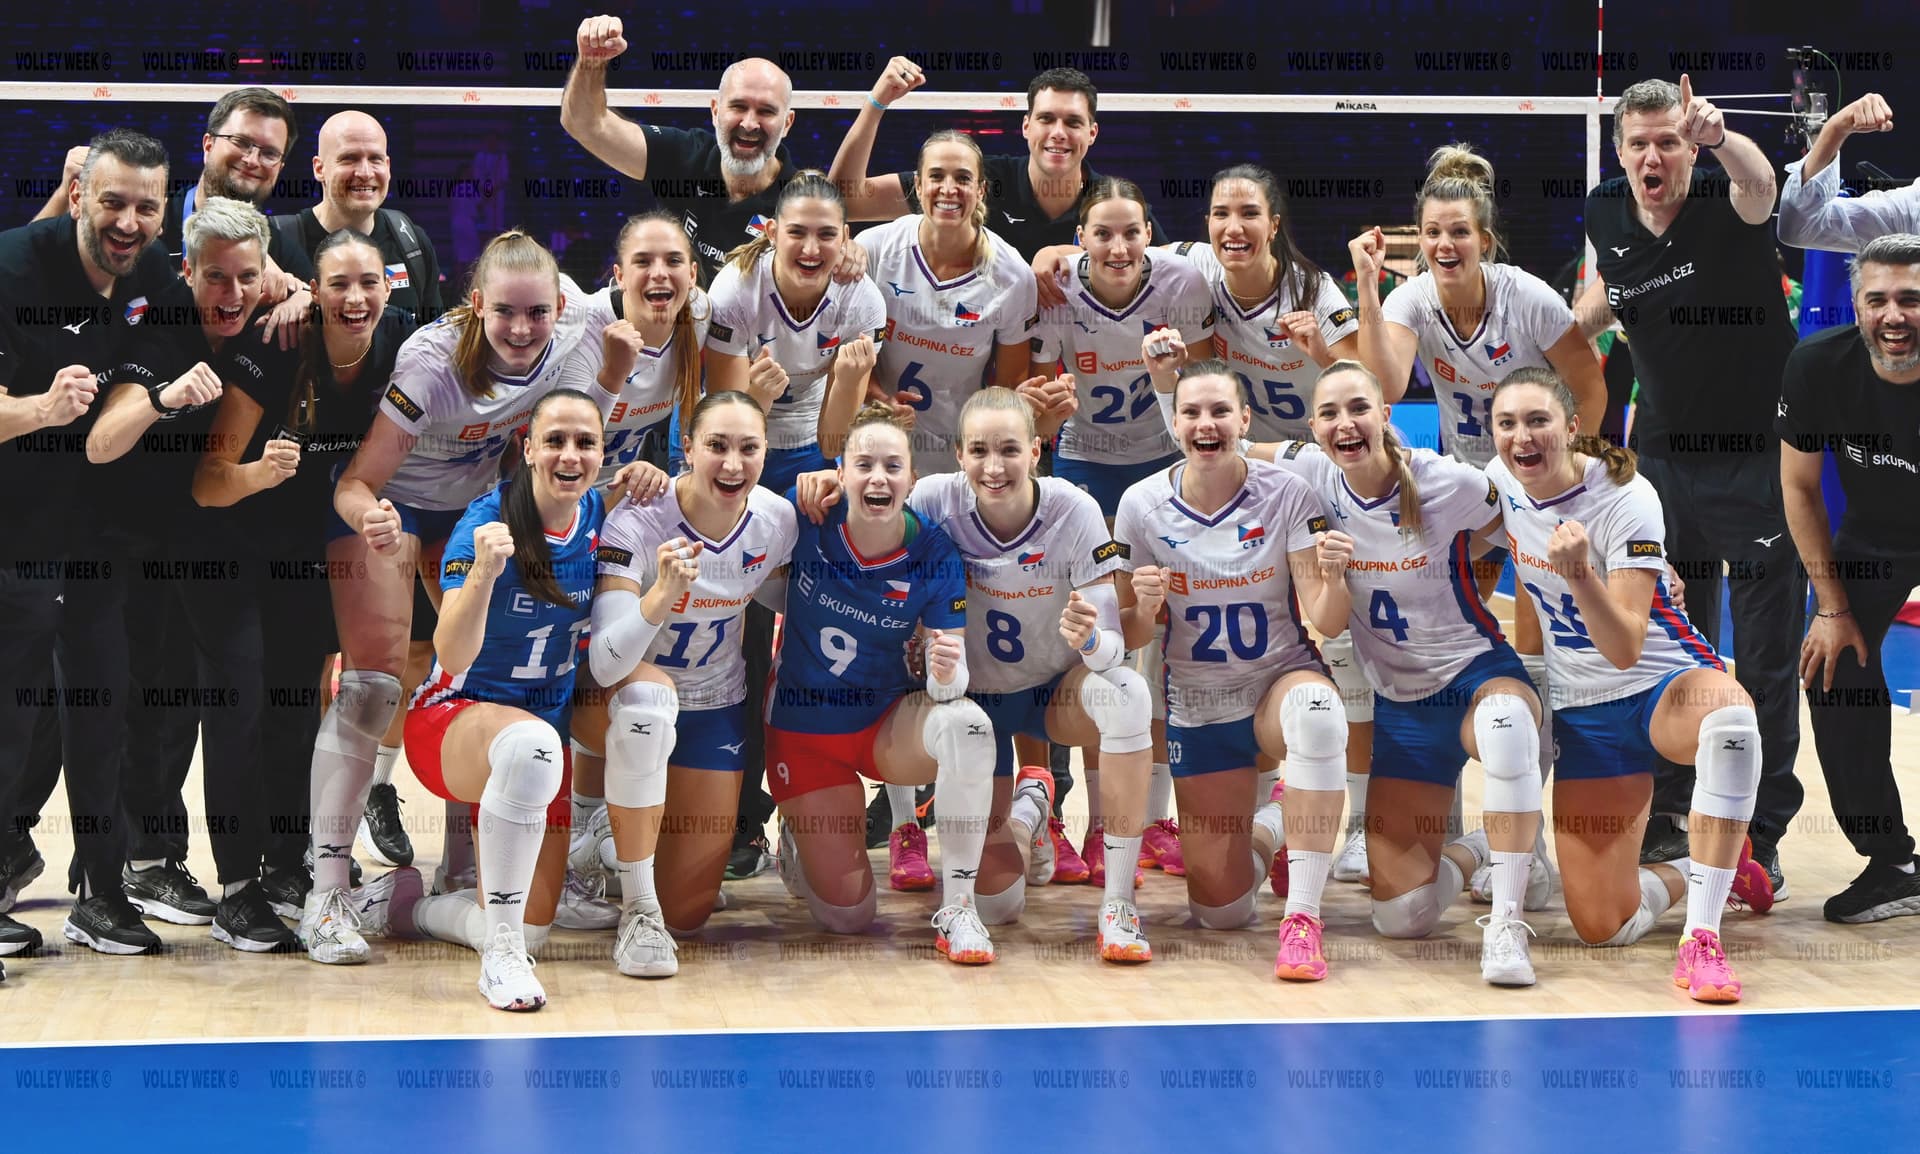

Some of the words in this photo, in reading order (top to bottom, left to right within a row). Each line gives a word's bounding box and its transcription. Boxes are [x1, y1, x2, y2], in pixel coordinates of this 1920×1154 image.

[1622, 273, 1673, 300] SKUPINA
[1671, 261, 1695, 280] ČEZ
[896, 331, 948, 354] SKUPINA
[950, 344, 975, 357] ČEZ
[1231, 351, 1279, 372] SKUPINA
[1281, 359, 1305, 372] ČEZ
[898, 361, 933, 412] 6
[307, 440, 361, 452] SKUPIN
[1243, 538, 1265, 550] CZE
[1401, 555, 1428, 571] ČEZ
[1193, 576, 1249, 590] SKUPINA
[1251, 566, 1276, 584] ČEZ
[692, 597, 742, 609] SKUPINA
[975, 582, 1025, 600] SKUPINA
[1027, 585, 1055, 598] ČEZ
[818, 593, 877, 626] SKUPINA
[880, 615, 910, 629] ČEZ
[881, 599, 905, 608] CZE
[1369, 589, 1410, 642] 4
[986, 608, 1025, 664] 8
[1185, 602, 1269, 663] 20
[819, 626, 858, 678] 9
[1167, 740, 1182, 764] 20
[776, 762, 790, 785] 9
